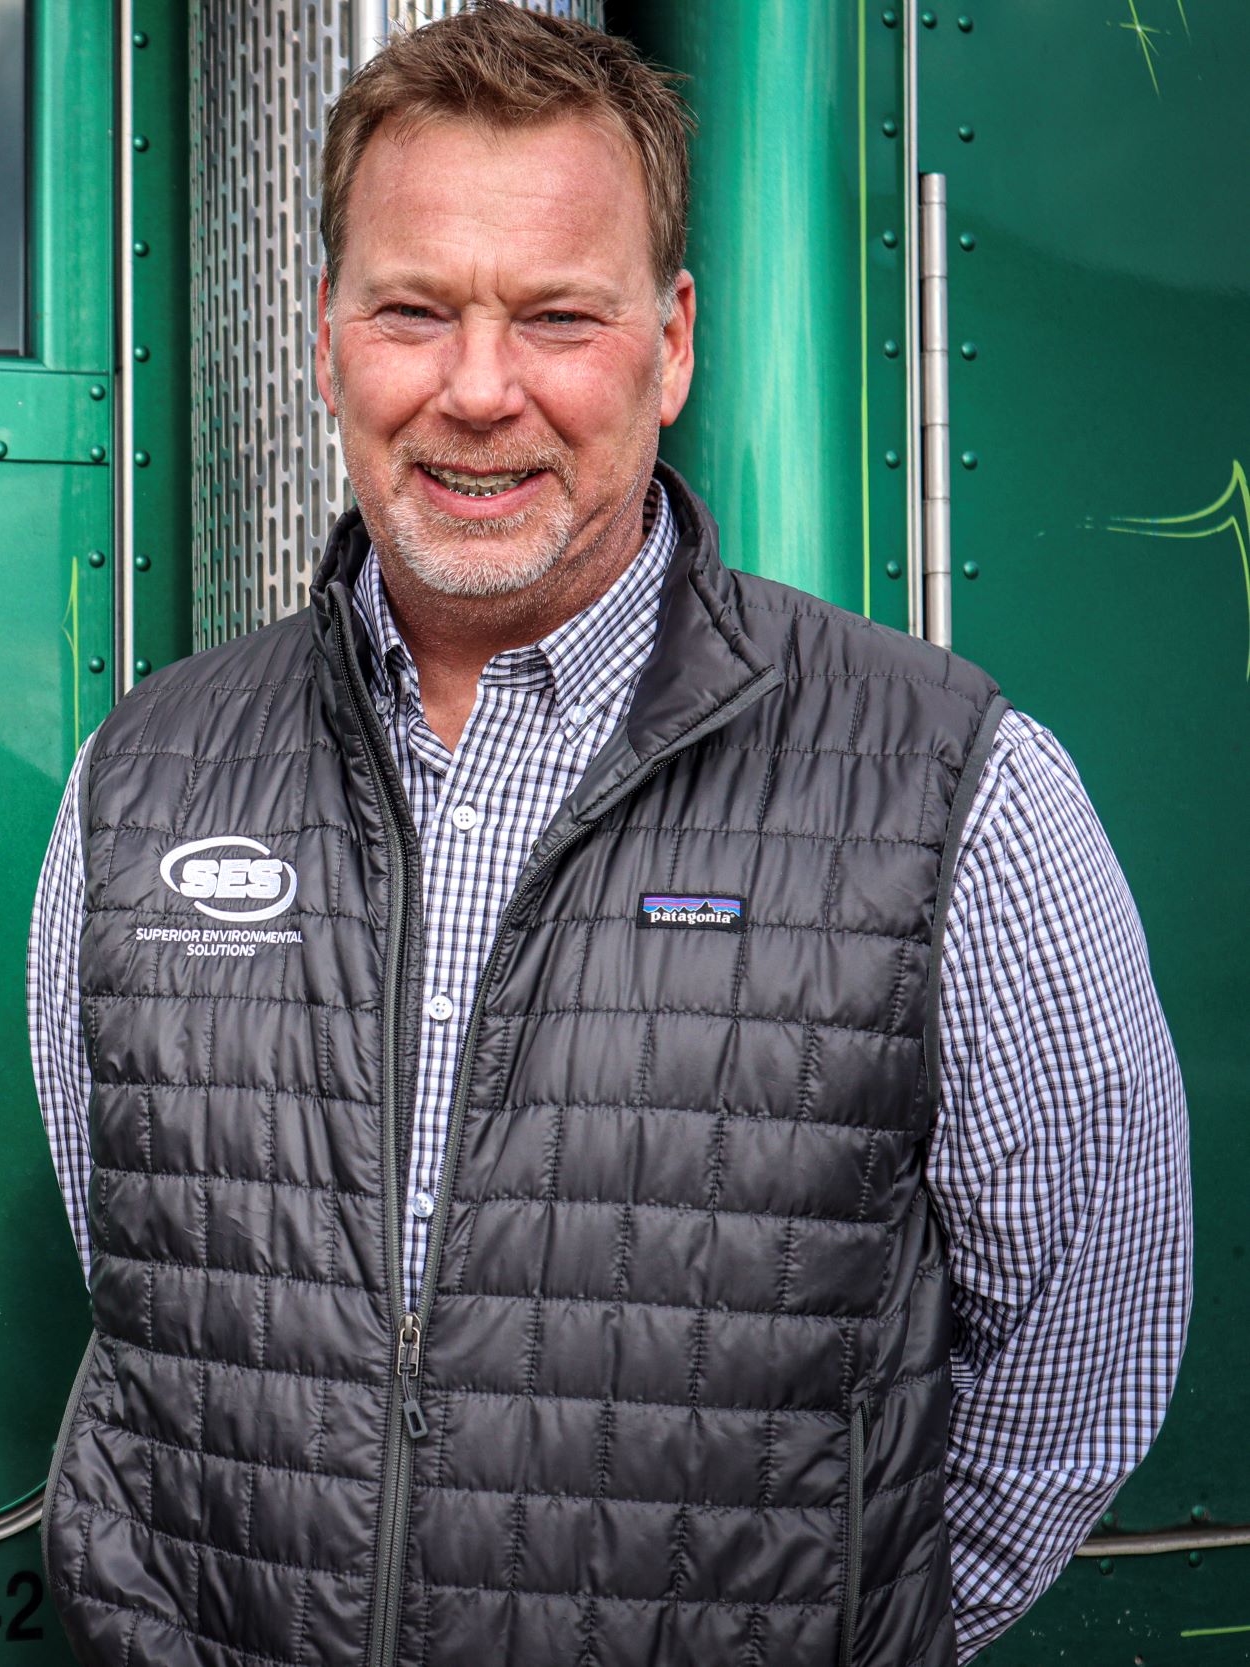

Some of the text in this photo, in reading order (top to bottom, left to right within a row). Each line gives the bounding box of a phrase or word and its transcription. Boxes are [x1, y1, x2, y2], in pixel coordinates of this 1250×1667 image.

[179, 858, 283, 899] SES
[650, 911, 732, 925] patagonia
[135, 927, 303, 944] SUPERIOR ENVIRONMENTAL
[186, 943, 256, 957] SOLUTIONS
